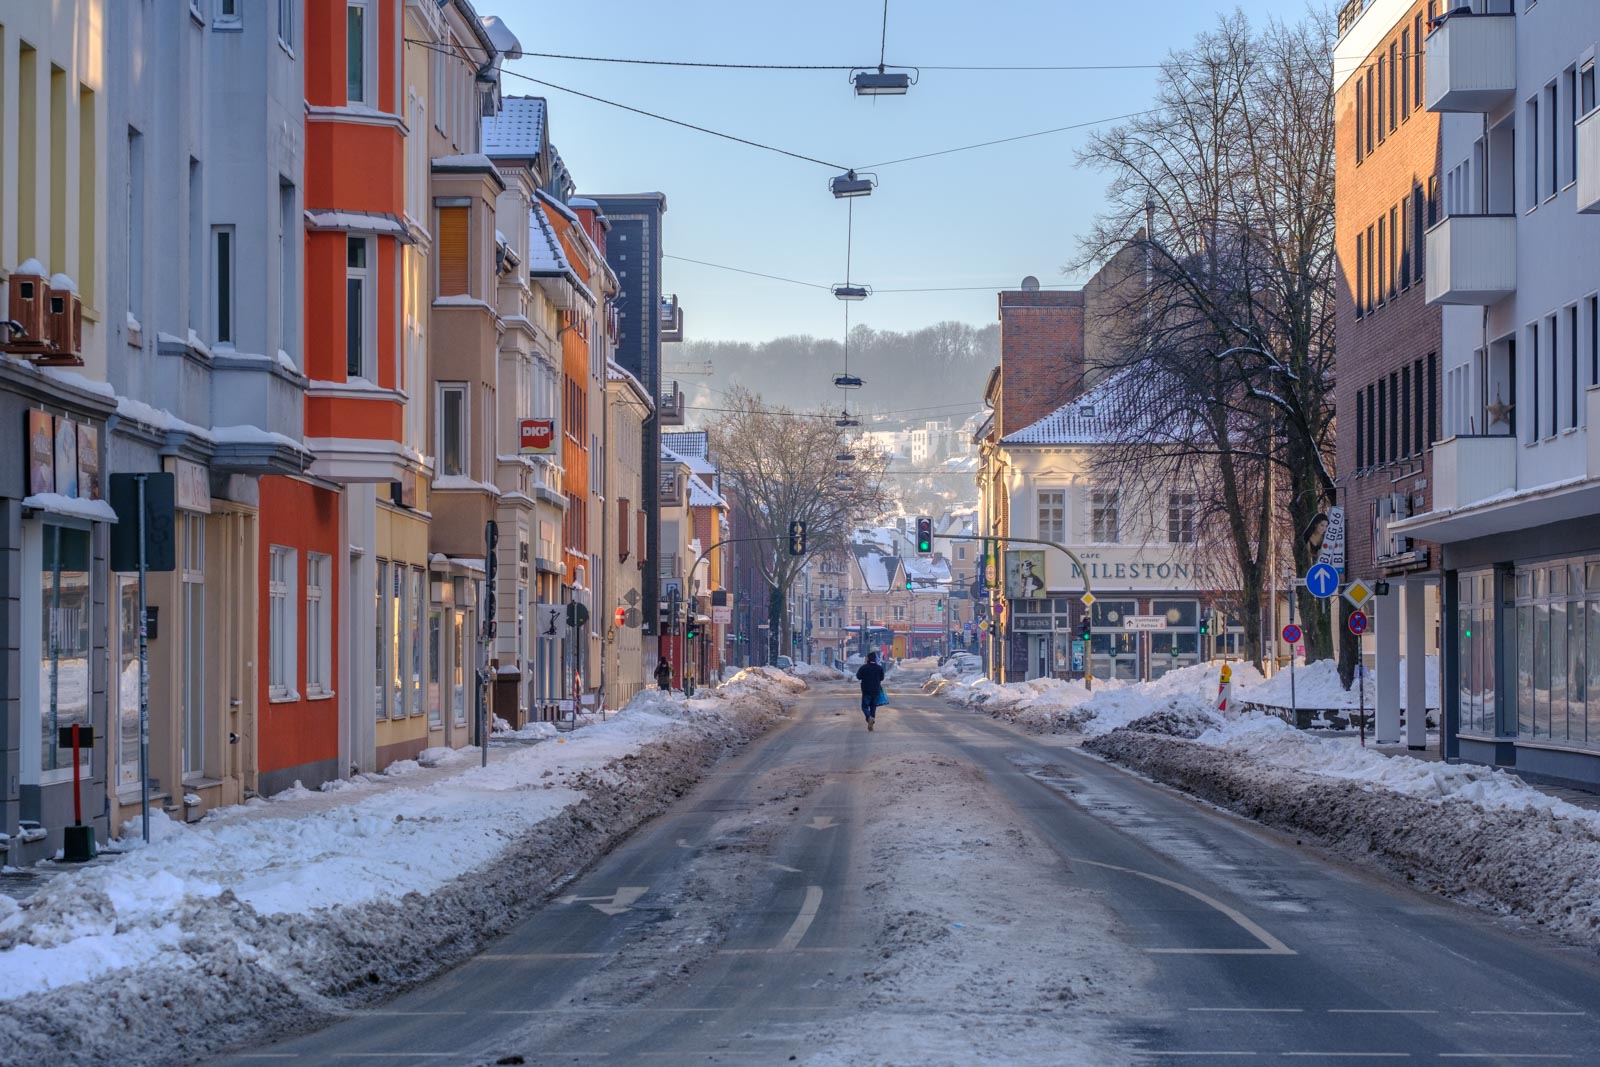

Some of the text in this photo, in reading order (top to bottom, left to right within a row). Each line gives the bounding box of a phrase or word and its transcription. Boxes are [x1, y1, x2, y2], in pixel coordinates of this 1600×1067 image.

[522, 426, 549, 437] DKP
[1330, 512, 1342, 525] 66
[1325, 527, 1338, 541] GG
[1333, 552, 1344, 564] BI
[1070, 562, 1216, 579] MILESTONES
